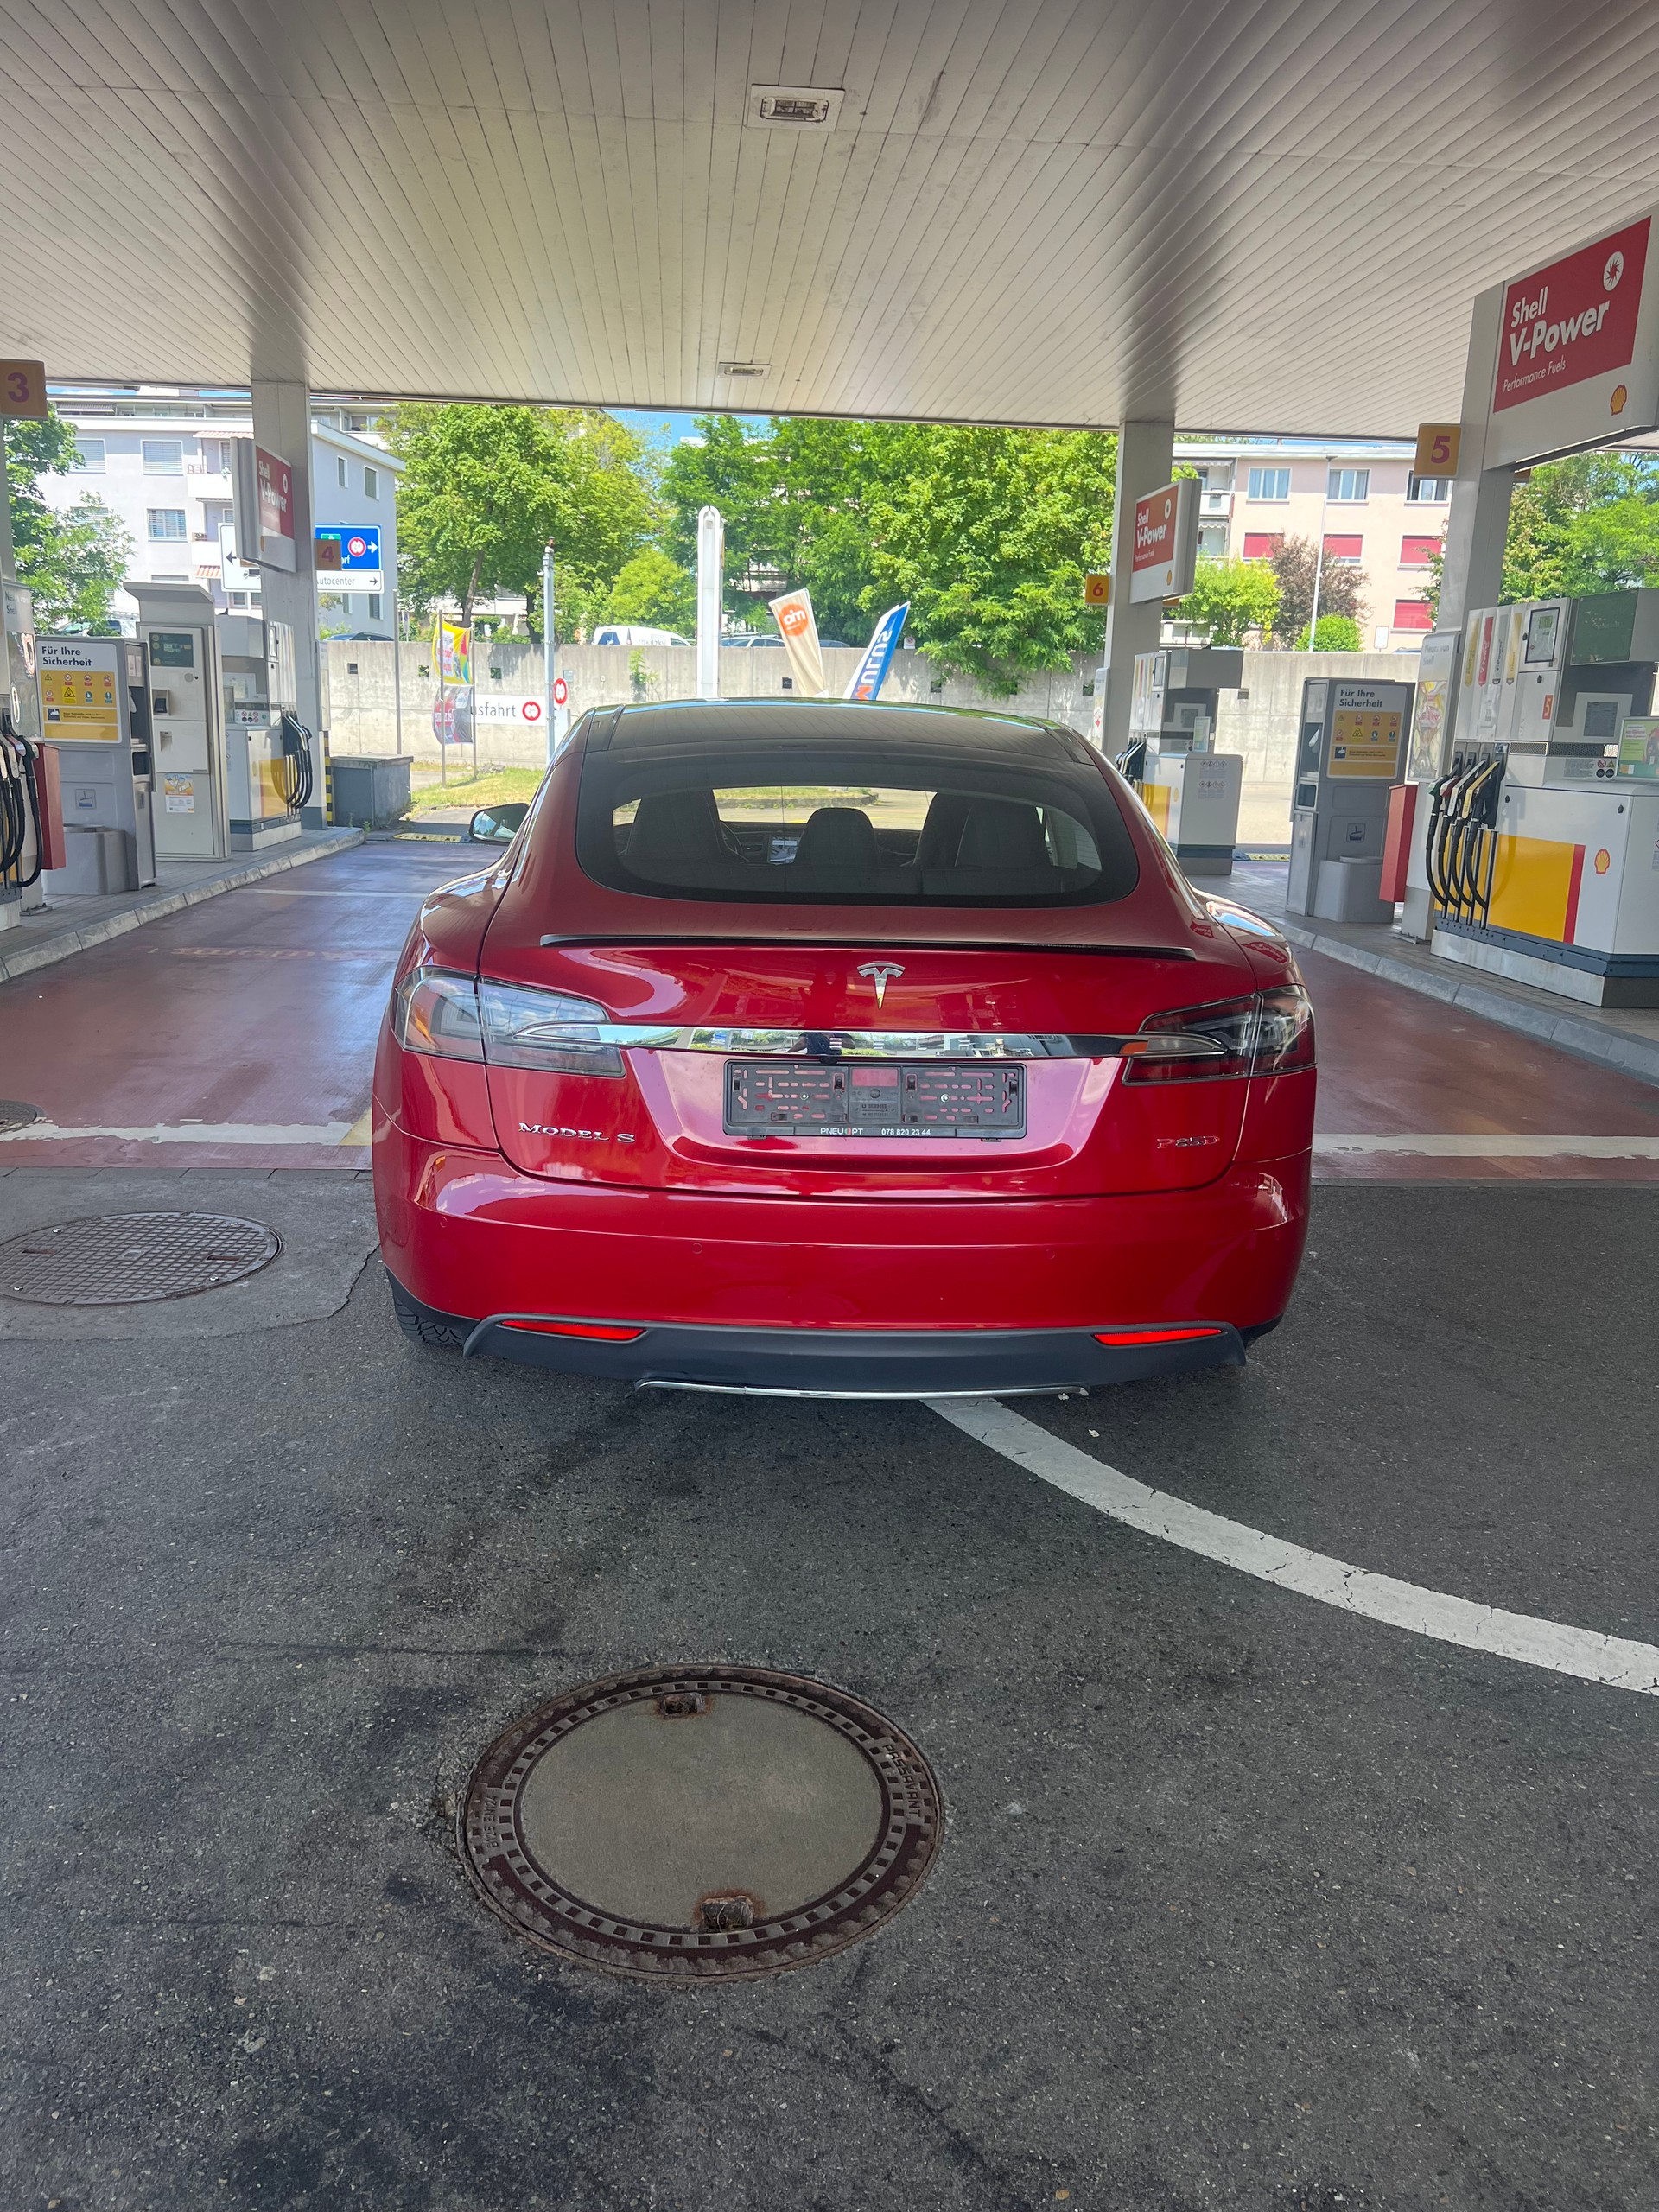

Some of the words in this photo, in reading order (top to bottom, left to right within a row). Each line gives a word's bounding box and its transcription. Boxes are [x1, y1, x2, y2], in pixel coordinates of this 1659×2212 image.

[1510, 286, 1549, 328] Shell
[1510, 300, 1611, 366] V-Power
[1503, 367, 1547, 392] Performance
[1548, 354, 1567, 375] Fuels
[7, 372, 30, 404] 3
[1430, 435, 1451, 464] 5
[259, 460, 270, 480] Shell
[260, 480, 287, 512] V-Power
[1137, 508, 1149, 527] Shell
[1137, 524, 1167, 549] V-Power
[321, 546, 334, 563] 4
[317, 575, 356, 586] utocenter
[1093, 582, 1103, 596] 6
[41, 646, 58, 655] Für
[61, 646, 81, 656] Ihre
[42, 657, 92, 667] Sicherheit
[1339, 699, 1383, 708] Sicherheit
[1340, 689, 1355, 697] Für
[1357, 690, 1376, 698] Ihre
[1543, 697, 1552, 717] 5
[518, 1122, 610, 1141] MODEL
[616, 1133, 636, 1143] S
[882, 1744, 922, 1818] PASSAVANT
